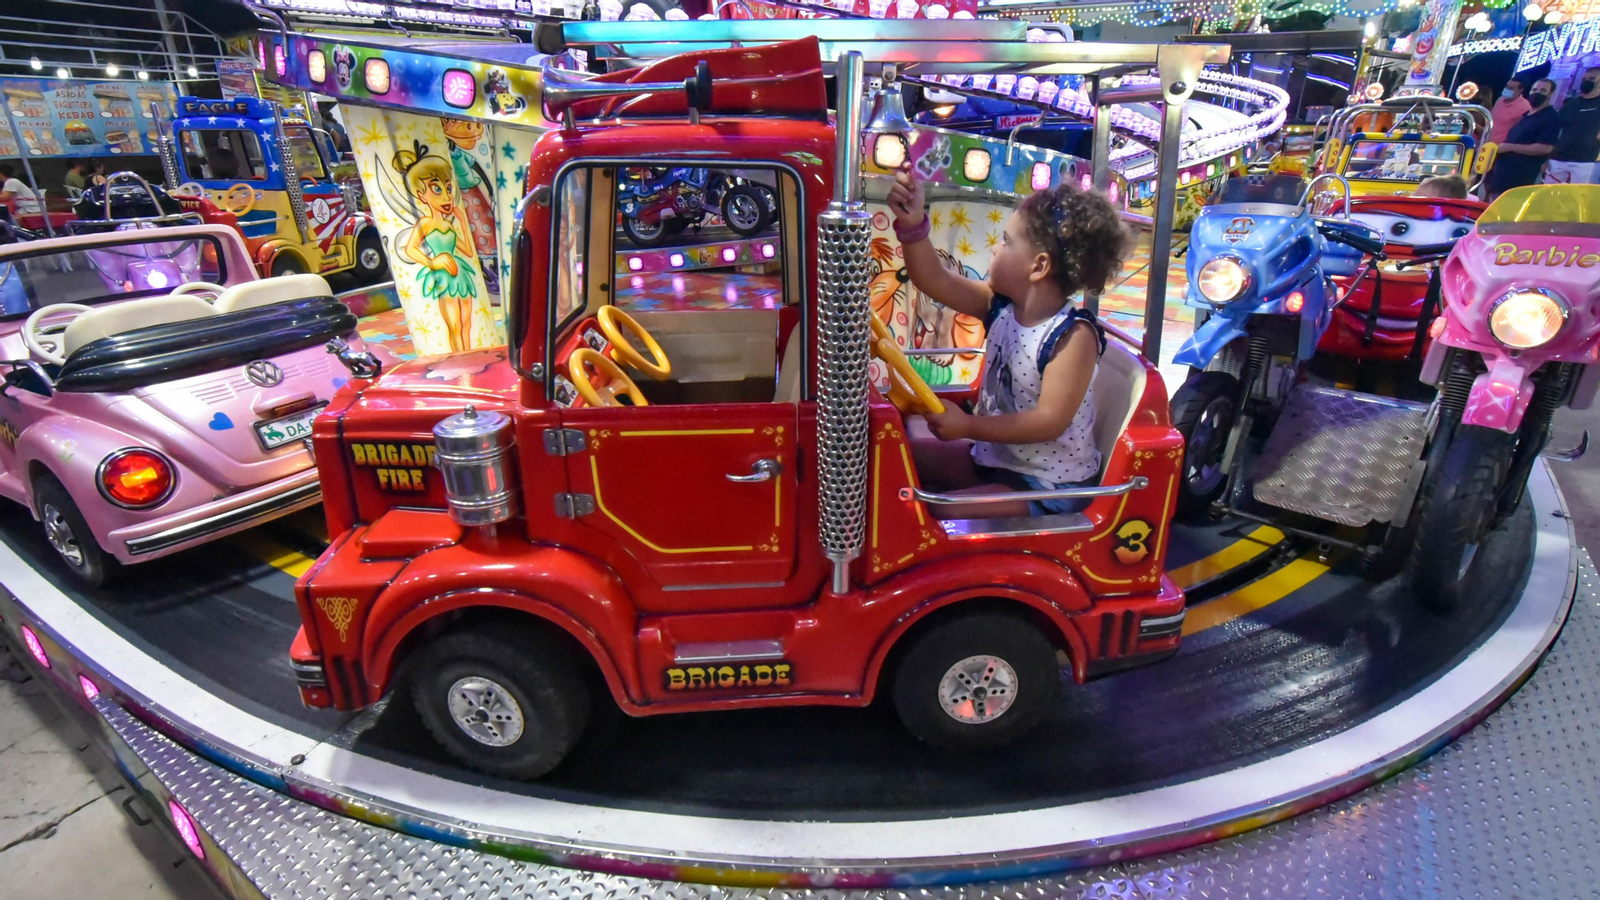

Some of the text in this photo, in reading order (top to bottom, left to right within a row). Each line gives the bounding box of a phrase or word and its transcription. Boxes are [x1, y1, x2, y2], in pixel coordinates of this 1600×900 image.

[56, 91, 87, 99] ASADAS
[58, 111, 95, 119] KEBAB
[184, 102, 248, 114] EAGLE
[625, 203, 634, 213] 3
[1493, 242, 1600, 268] Barbie
[377, 468, 425, 491] FIRE
[1114, 519, 1153, 565] 3
[666, 664, 791, 691] BRIGADE
